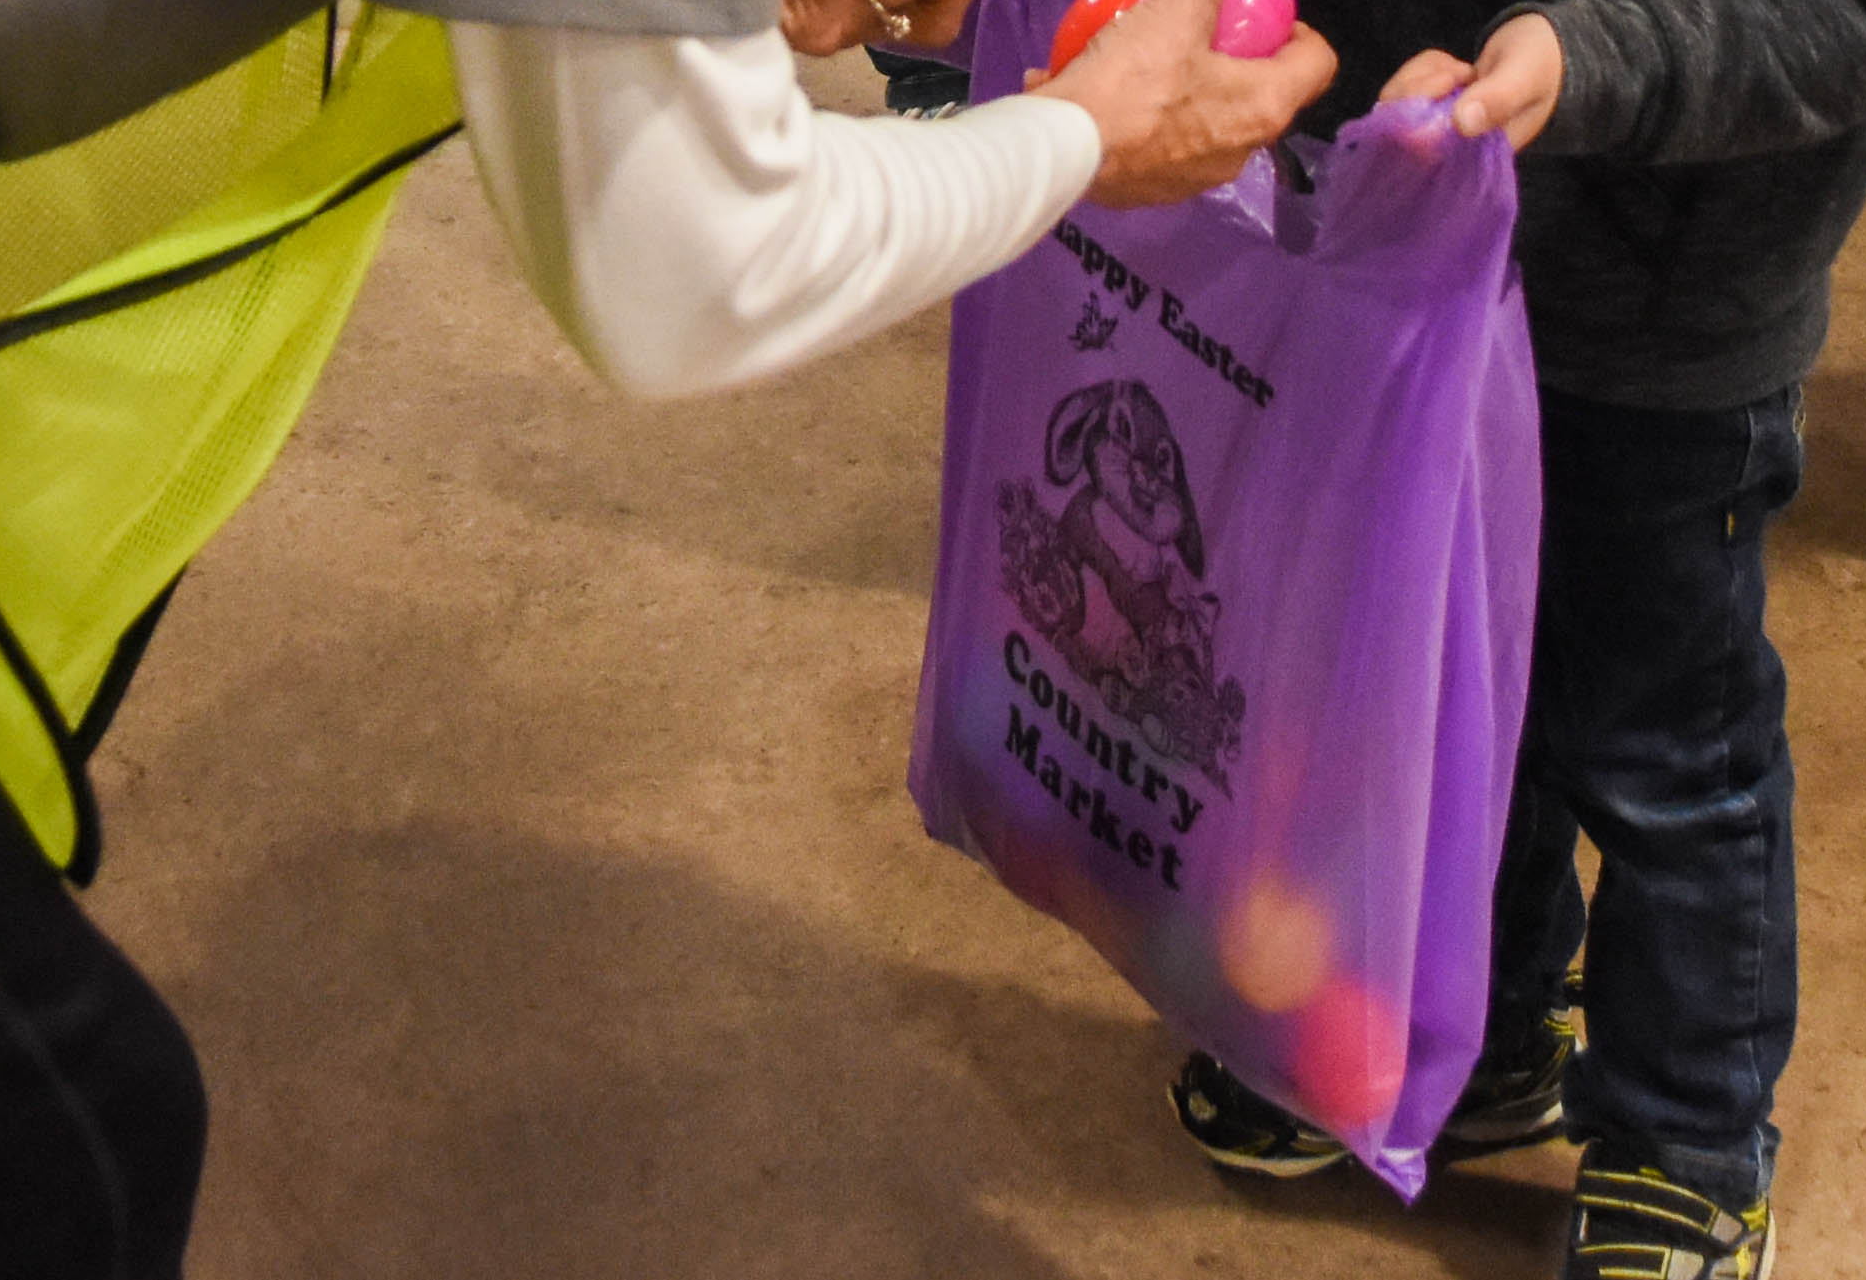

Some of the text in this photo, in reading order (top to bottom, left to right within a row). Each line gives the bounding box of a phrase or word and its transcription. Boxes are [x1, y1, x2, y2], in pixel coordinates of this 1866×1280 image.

[1055, 218, 1275, 408] appy Easter
[1004, 631, 1204, 834] Country
[1004, 702, 1182, 891] Market
